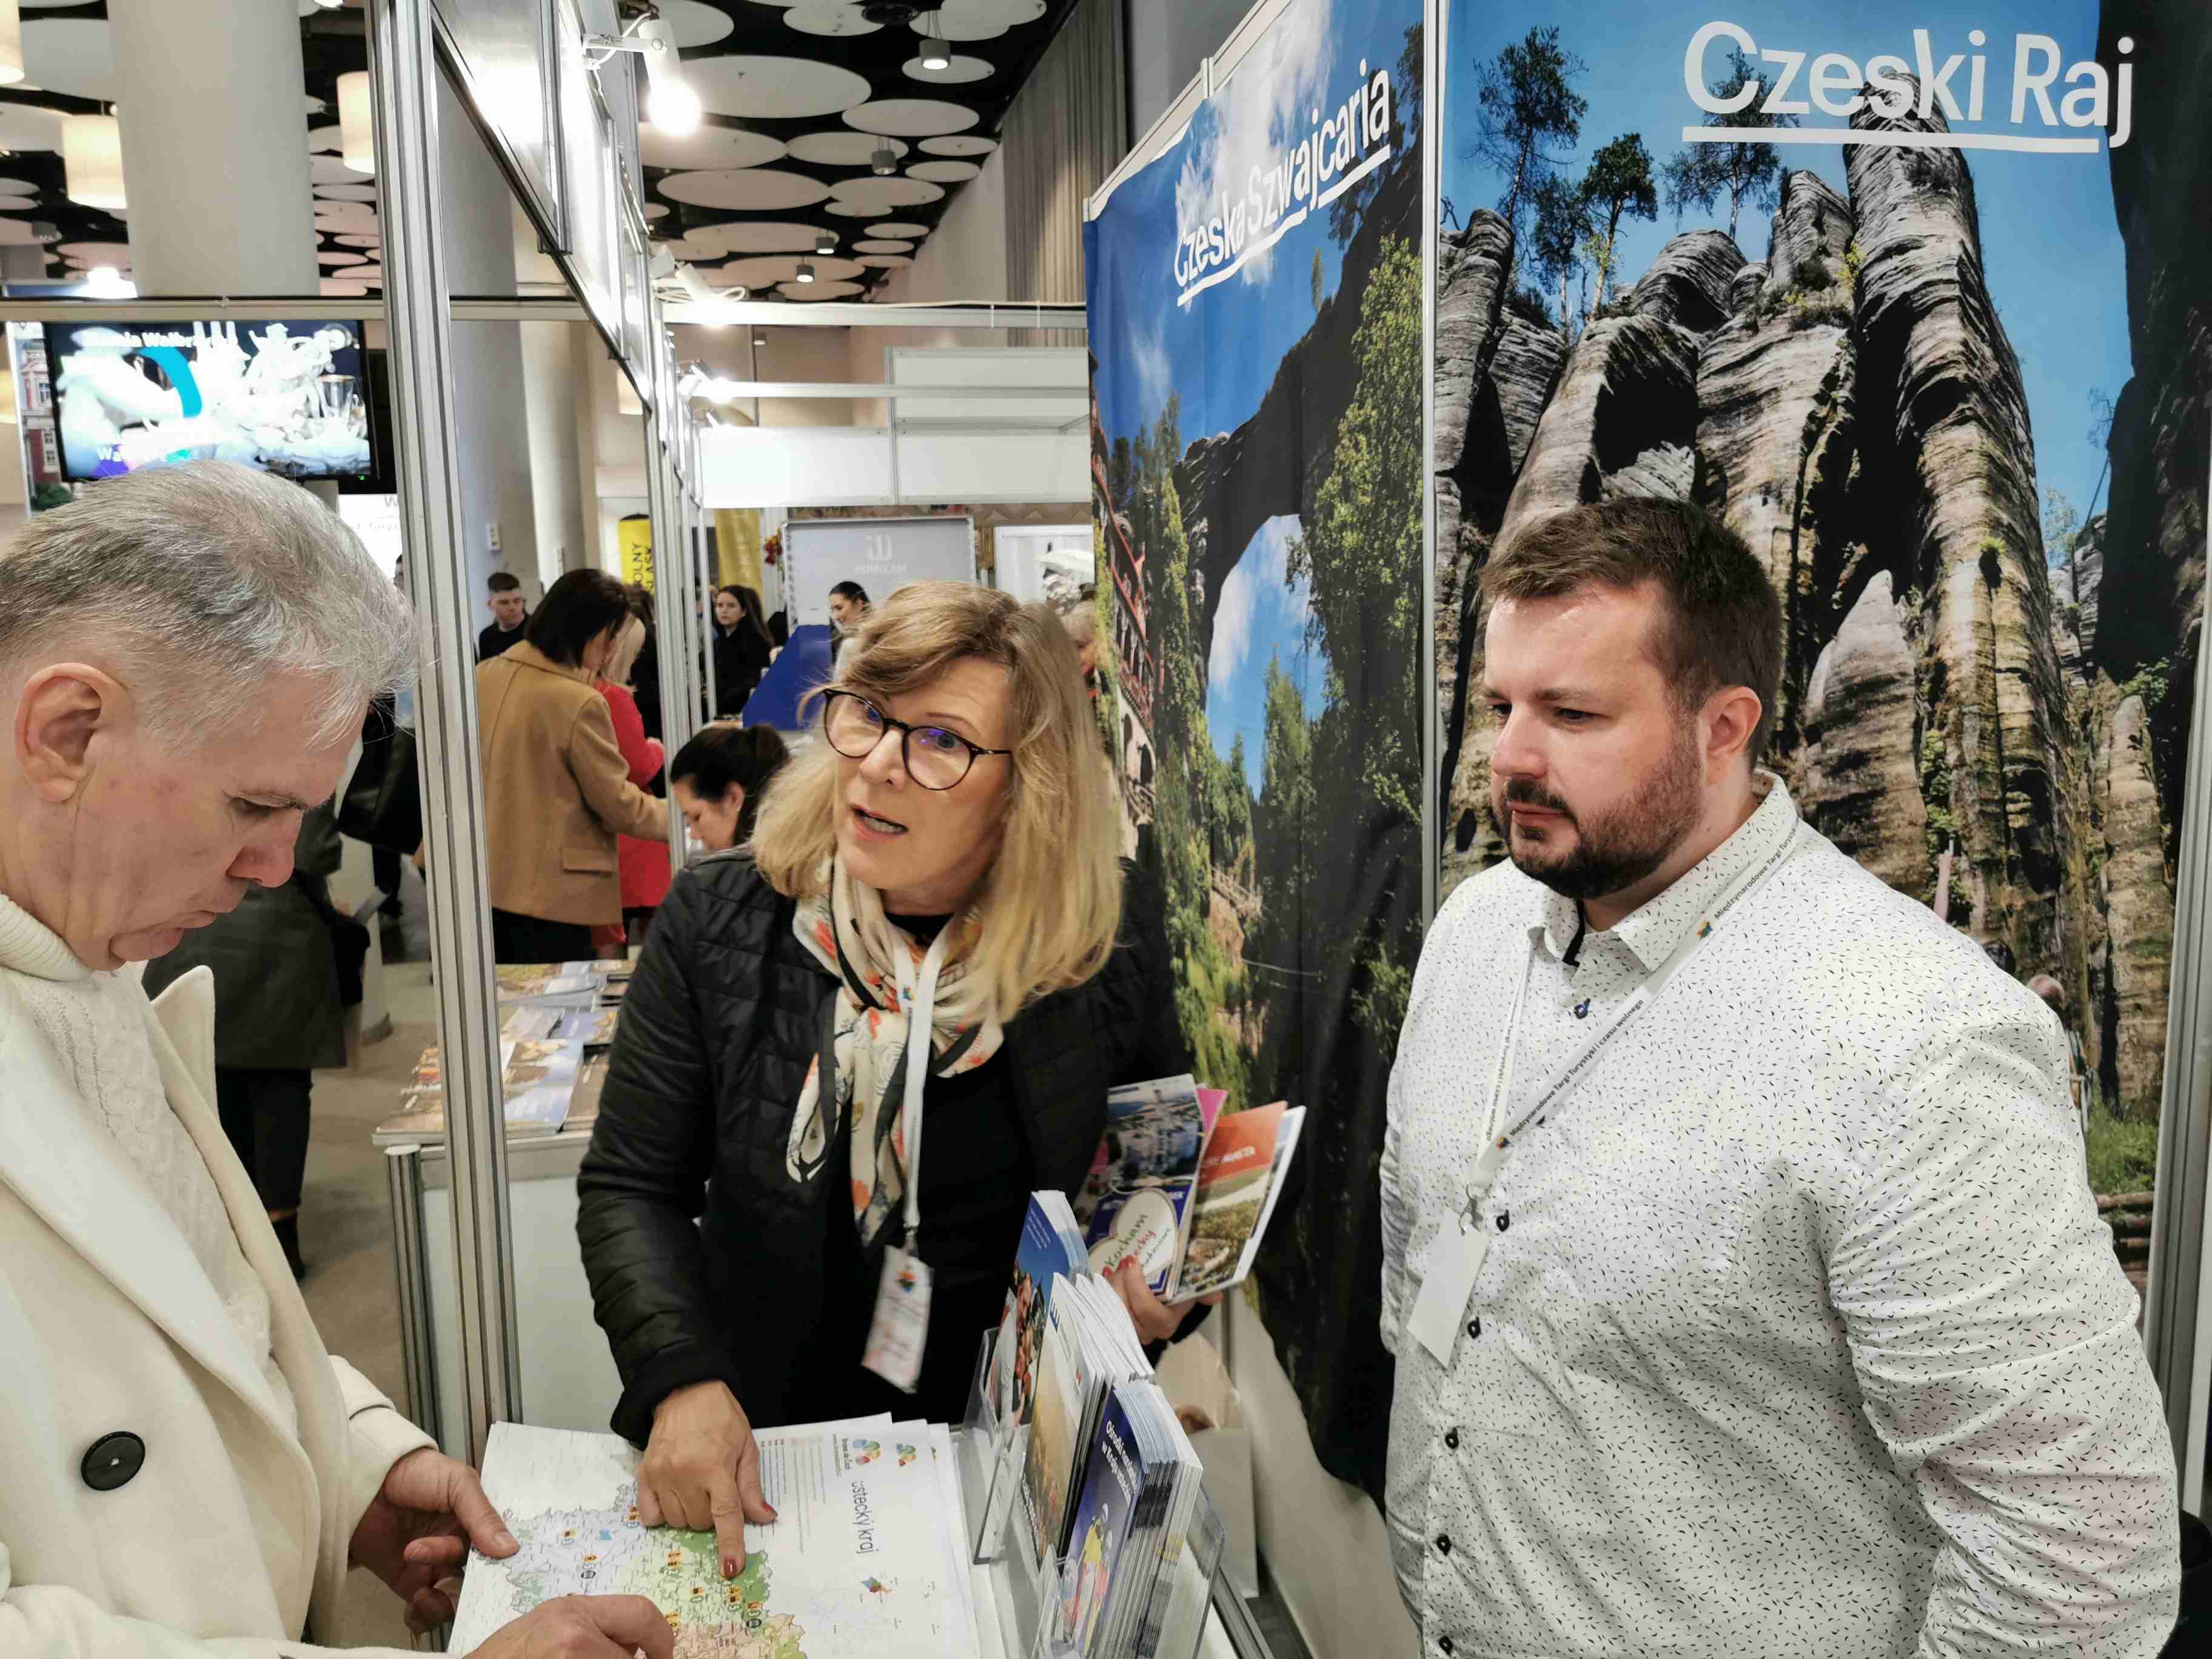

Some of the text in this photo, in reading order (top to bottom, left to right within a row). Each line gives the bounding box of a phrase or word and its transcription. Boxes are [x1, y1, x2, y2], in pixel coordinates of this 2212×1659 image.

[1683, 21, 2135, 149] Czeski Raj
[1174, 58, 1390, 287] Czeska Szwajcaria
[632, 543, 643, 583] OLNY
[1714, 865, 1768, 920] Międzynarodowe
[1766, 848, 1782, 867] Targi
[1509, 1090, 1556, 1136] Międzynarodowe
[1553, 1073, 1570, 1091] Targi
[1568, 1046, 1598, 1076] Turystyki
[1599, 1027, 1618, 1046] czasu
[1615, 999, 1644, 1028] wolnego
[856, 1527, 879, 1554] kraj
